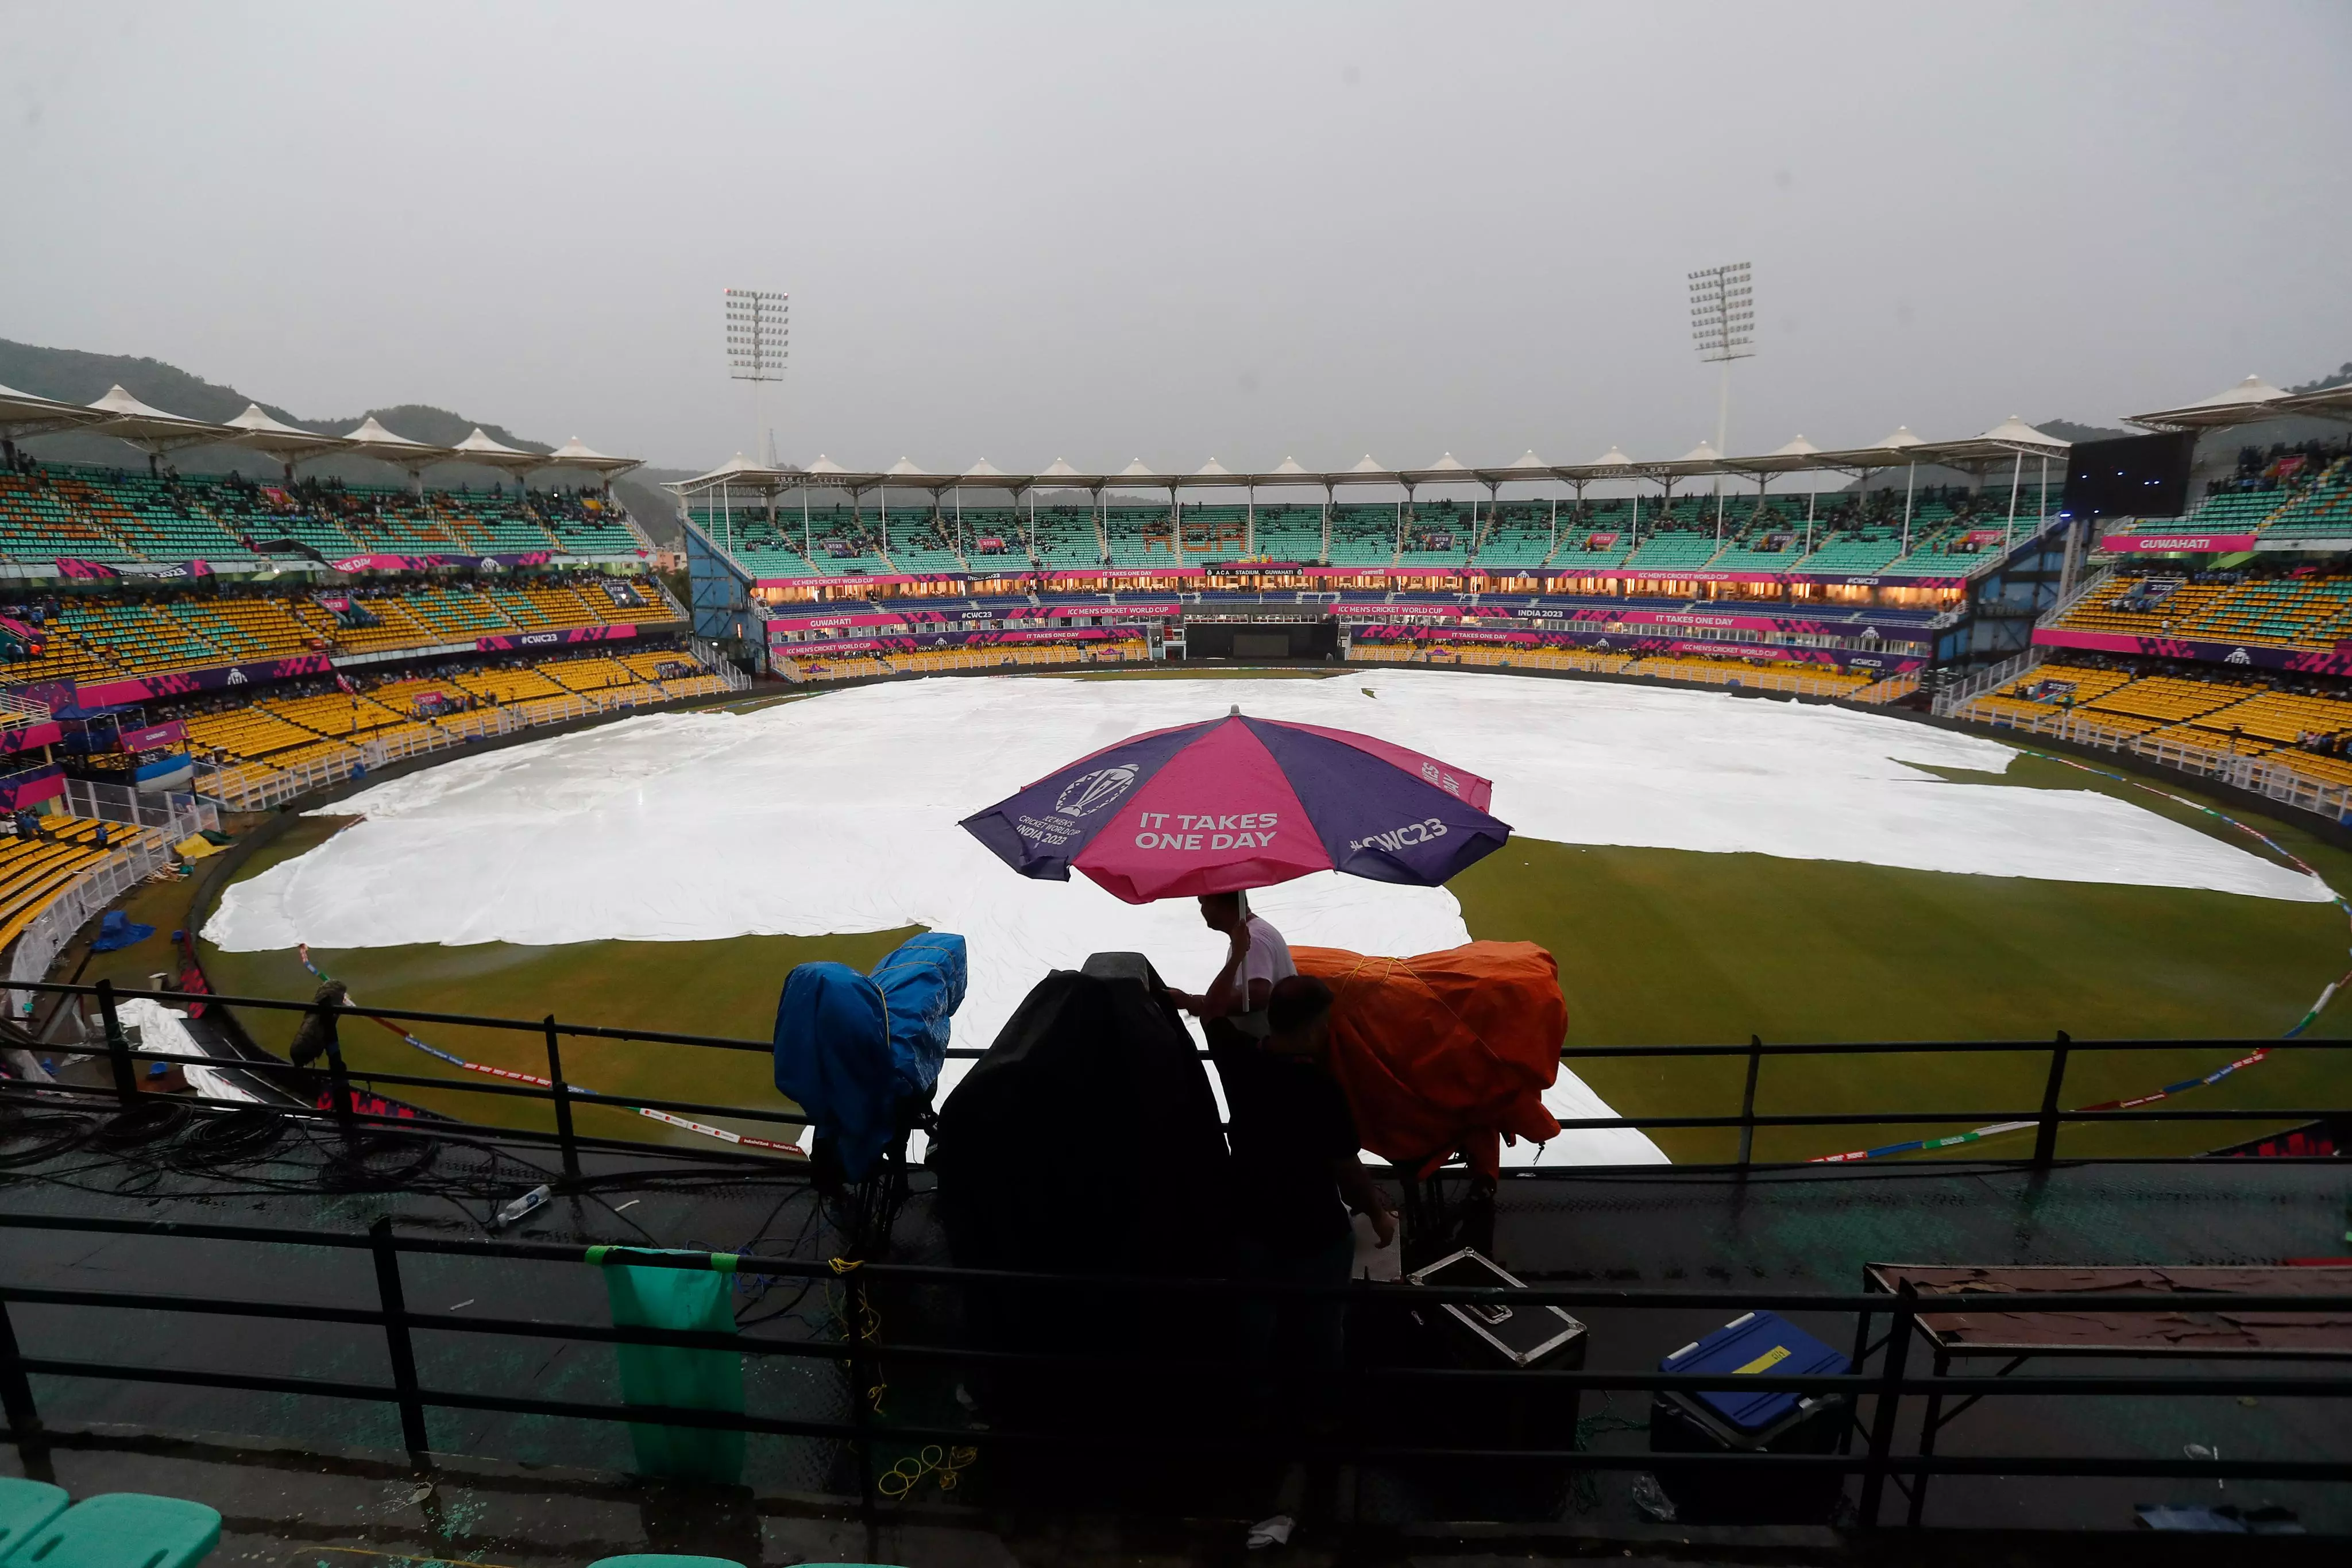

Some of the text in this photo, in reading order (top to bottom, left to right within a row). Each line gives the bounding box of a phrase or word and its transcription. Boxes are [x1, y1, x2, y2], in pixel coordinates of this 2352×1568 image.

[2139, 539, 2210, 549] GUWAHATI
[810, 618, 851, 627] GUWAHATI
[1666, 615, 1694, 623] TAKES
[521, 633, 558, 644] #CWC23
[1019, 815, 1048, 828] CRICKET
[1046, 824, 1069, 835] WORLD
[1053, 817, 1076, 827] MEN'S
[1140, 812, 1278, 830] IT TAKES
[1016, 824, 1068, 845] INDIA 2023
[1135, 831, 1277, 850] ONE DAY
[1350, 818, 1447, 852] #CWC23
